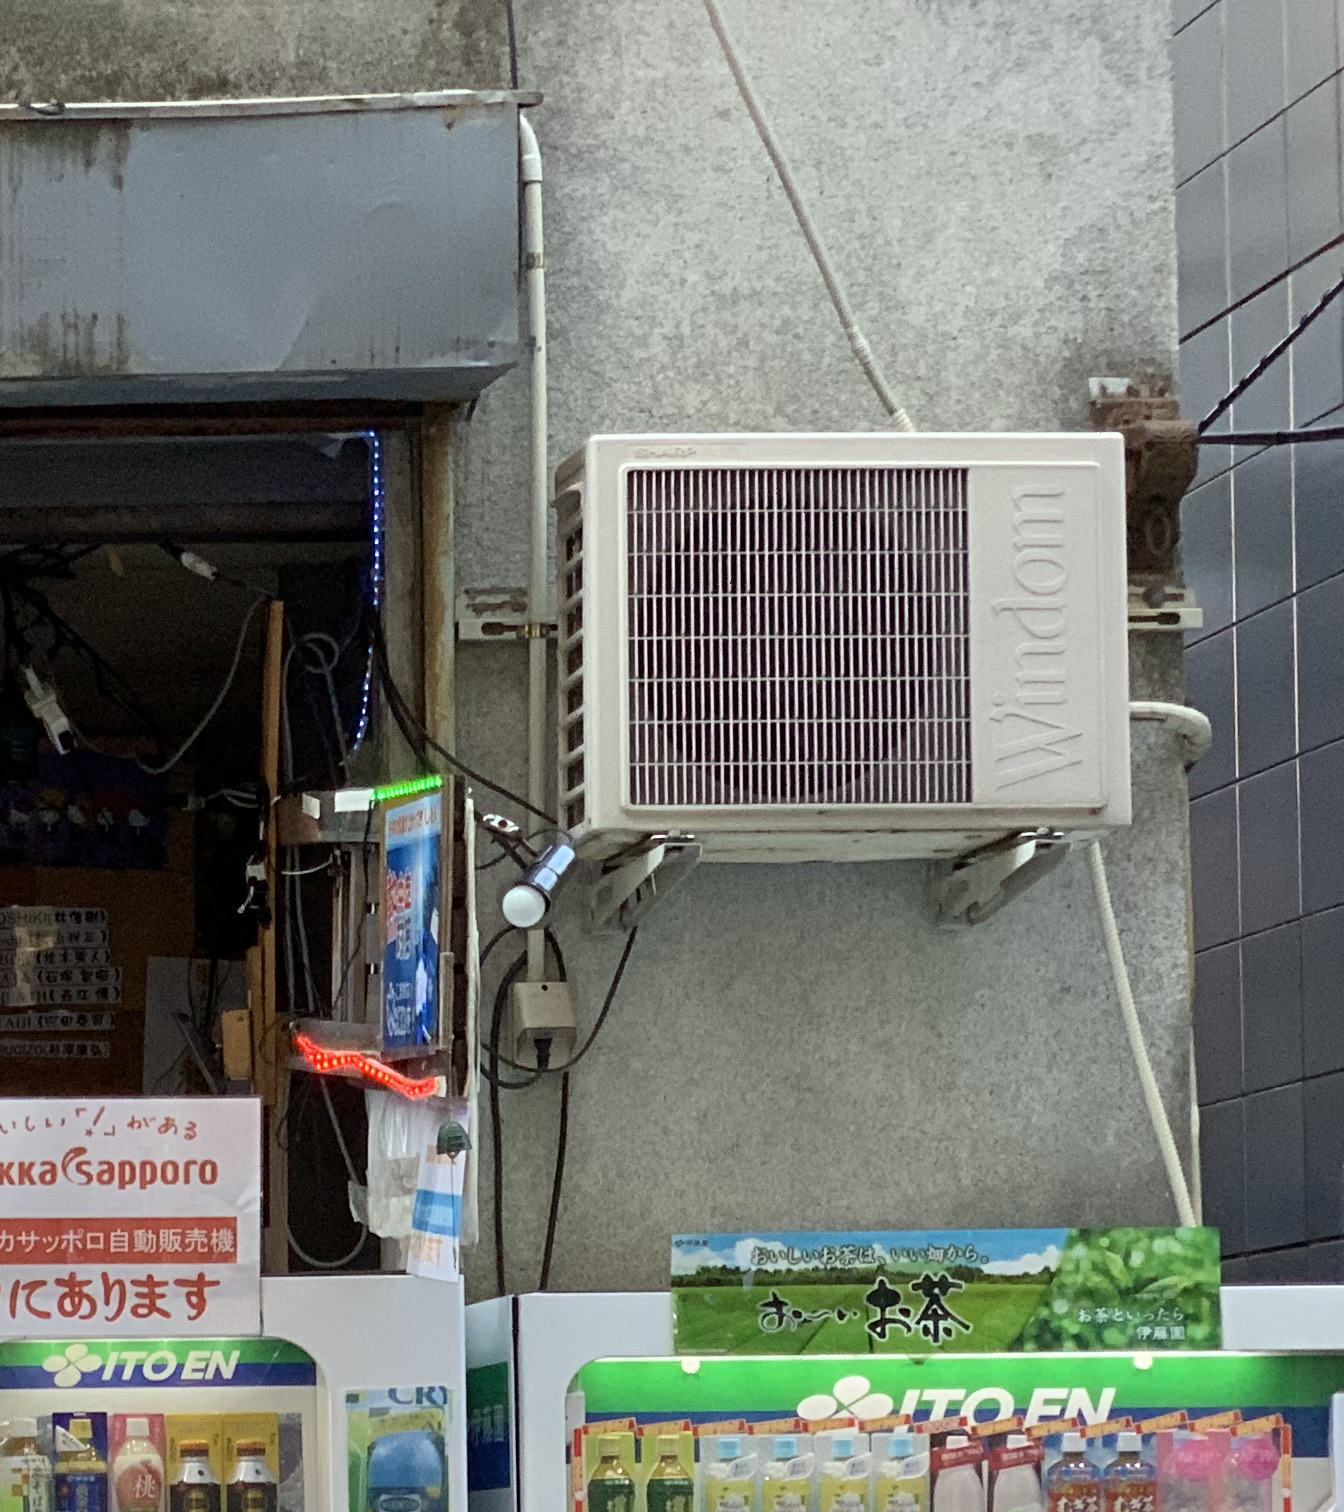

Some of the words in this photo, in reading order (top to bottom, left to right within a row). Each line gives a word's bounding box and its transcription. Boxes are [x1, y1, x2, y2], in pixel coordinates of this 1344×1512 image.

[991, 482, 1085, 792] Windom
[1135, 1325, 1187, 1341] 伊藤園
[102, 1350, 177, 1382] ITO
[180, 1350, 241, 1382] EN
[132, 1474, 157, 1500] 桃
